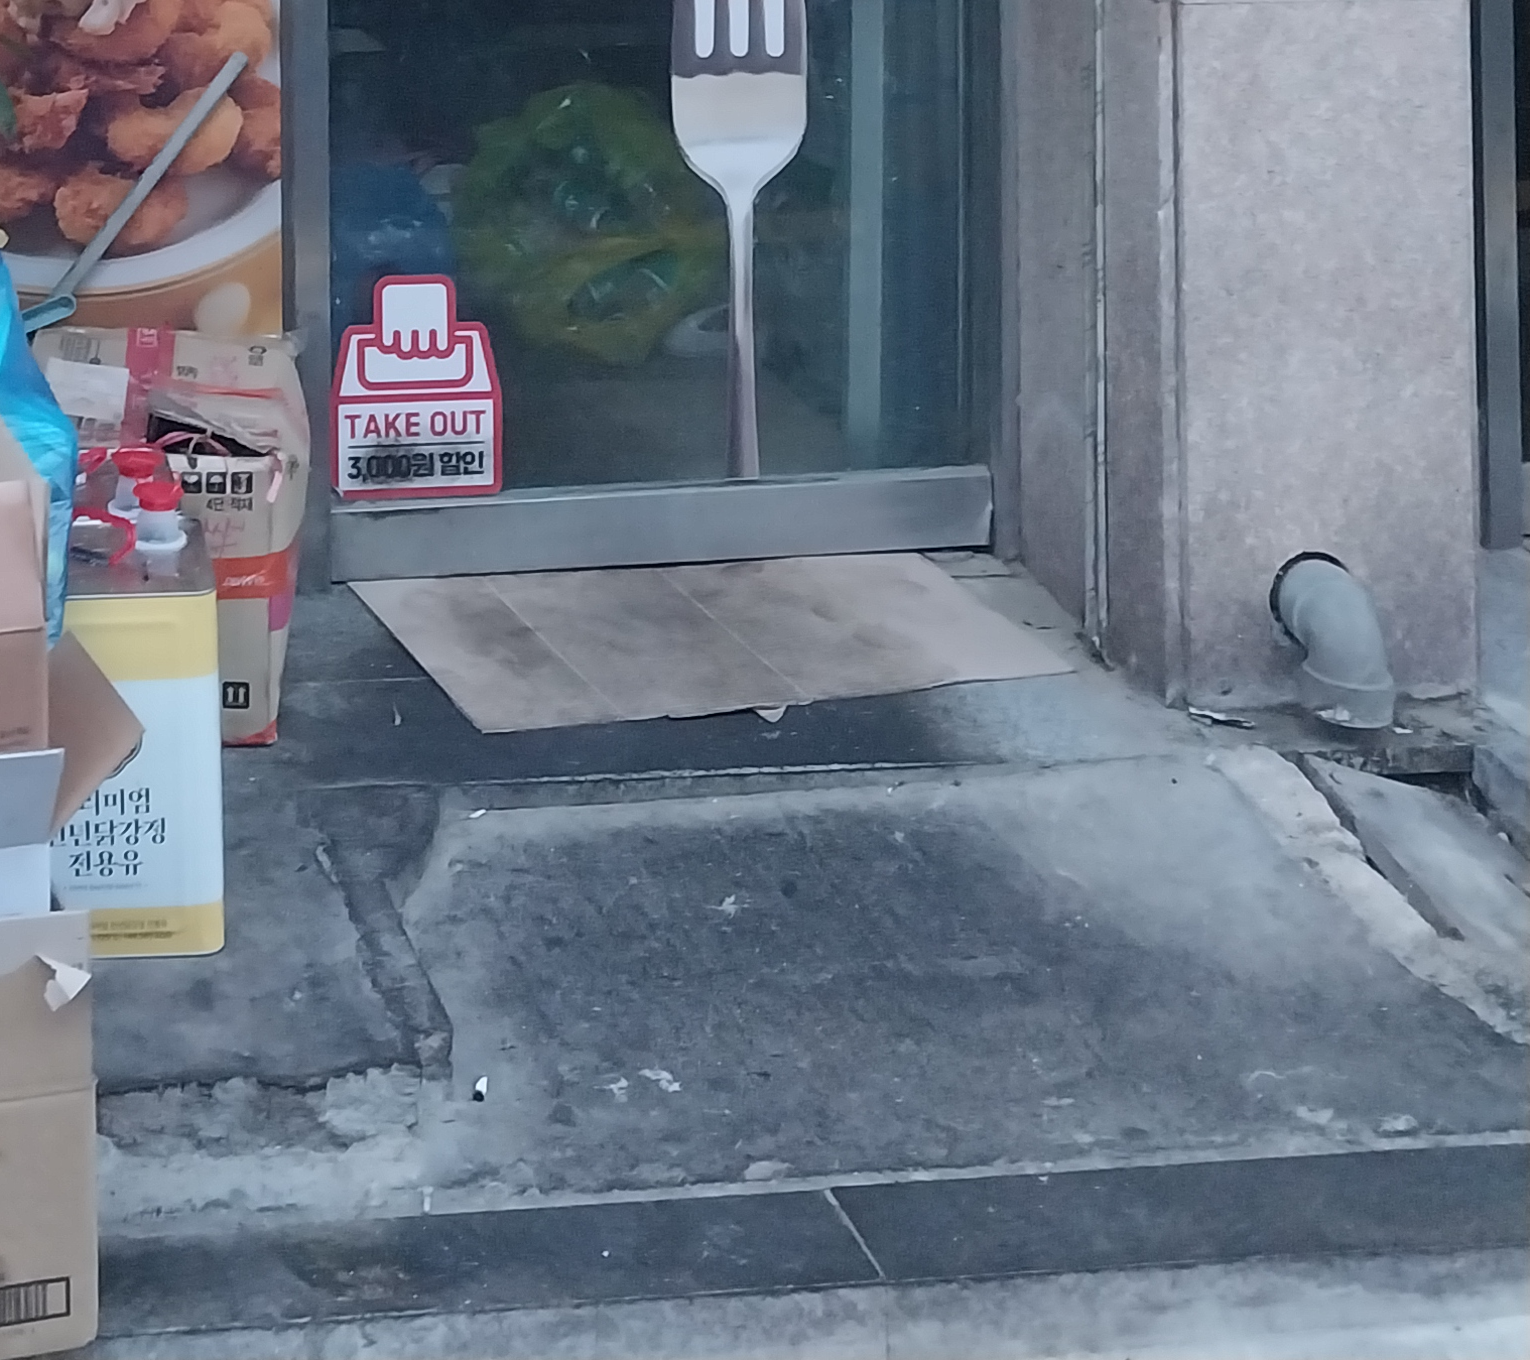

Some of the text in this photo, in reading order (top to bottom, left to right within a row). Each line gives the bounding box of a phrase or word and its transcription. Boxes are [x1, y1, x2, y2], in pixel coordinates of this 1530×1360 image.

[344, 409, 487, 440] TAKE OUT
[439, 450, 486, 477] 할인
[79, 787, 152, 816] 리미엄
[68, 849, 145, 878] 전용유
